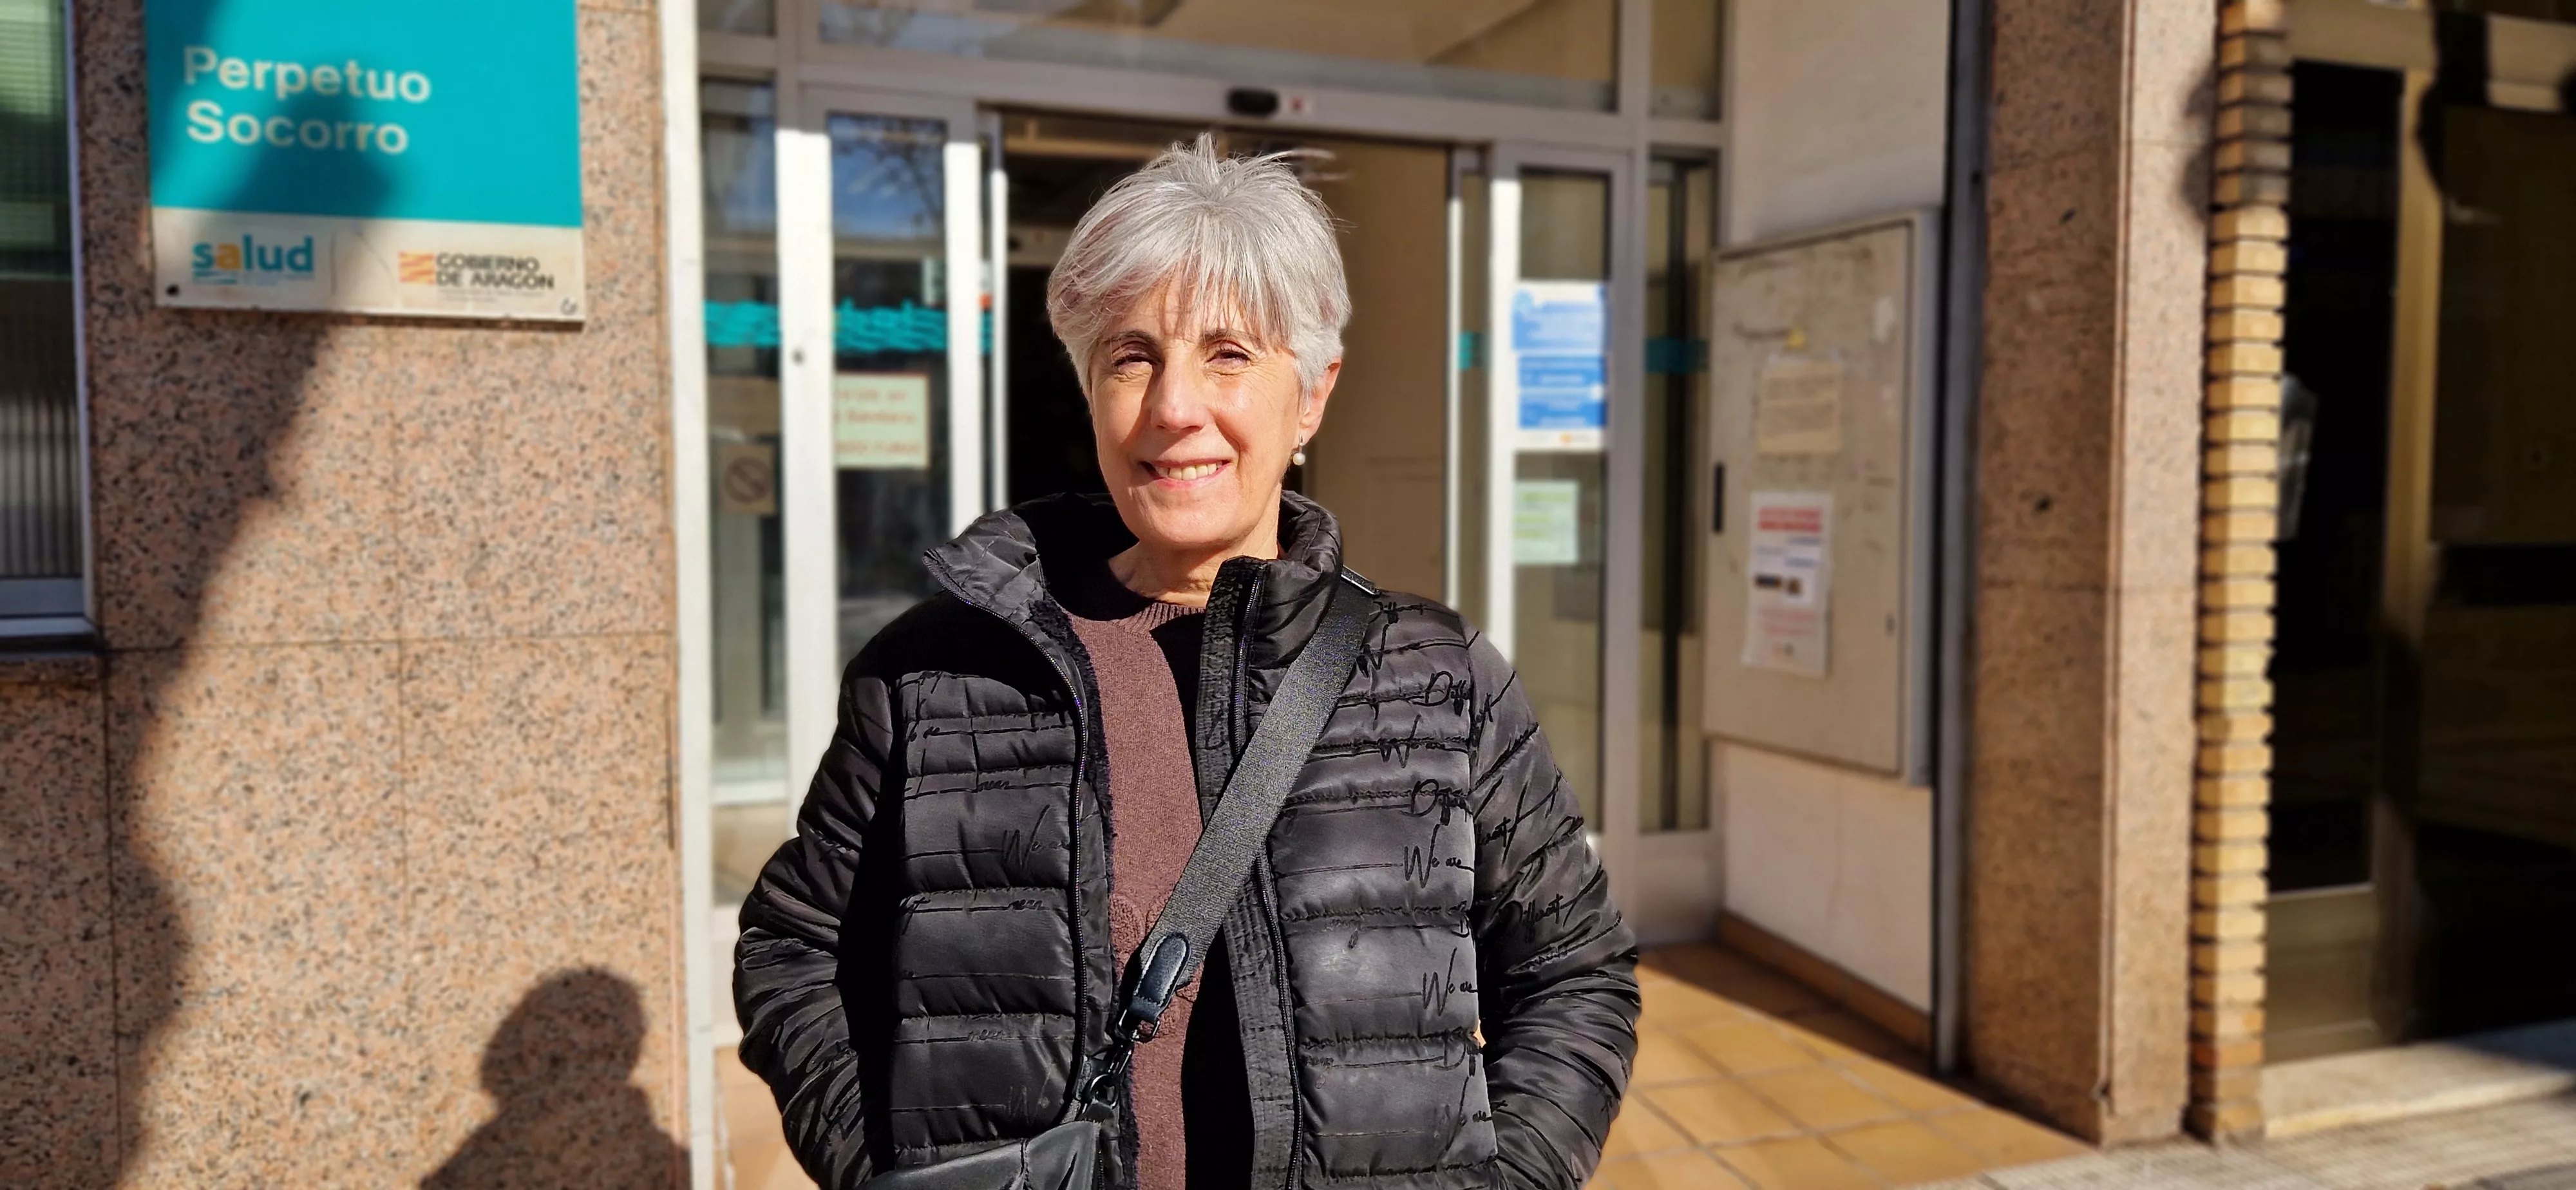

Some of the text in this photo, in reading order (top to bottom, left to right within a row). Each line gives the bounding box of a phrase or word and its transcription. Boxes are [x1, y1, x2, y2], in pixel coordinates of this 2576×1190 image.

[184, 45, 431, 104] Perpetuo
[186, 100, 409, 155] Socorro
[193, 234, 314, 273] salud
[436, 252, 540, 273] GOBIERNO
[437, 269, 462, 287] DE
[1403, 823, 1440, 889] We
[1421, 946, 1457, 1017] We
